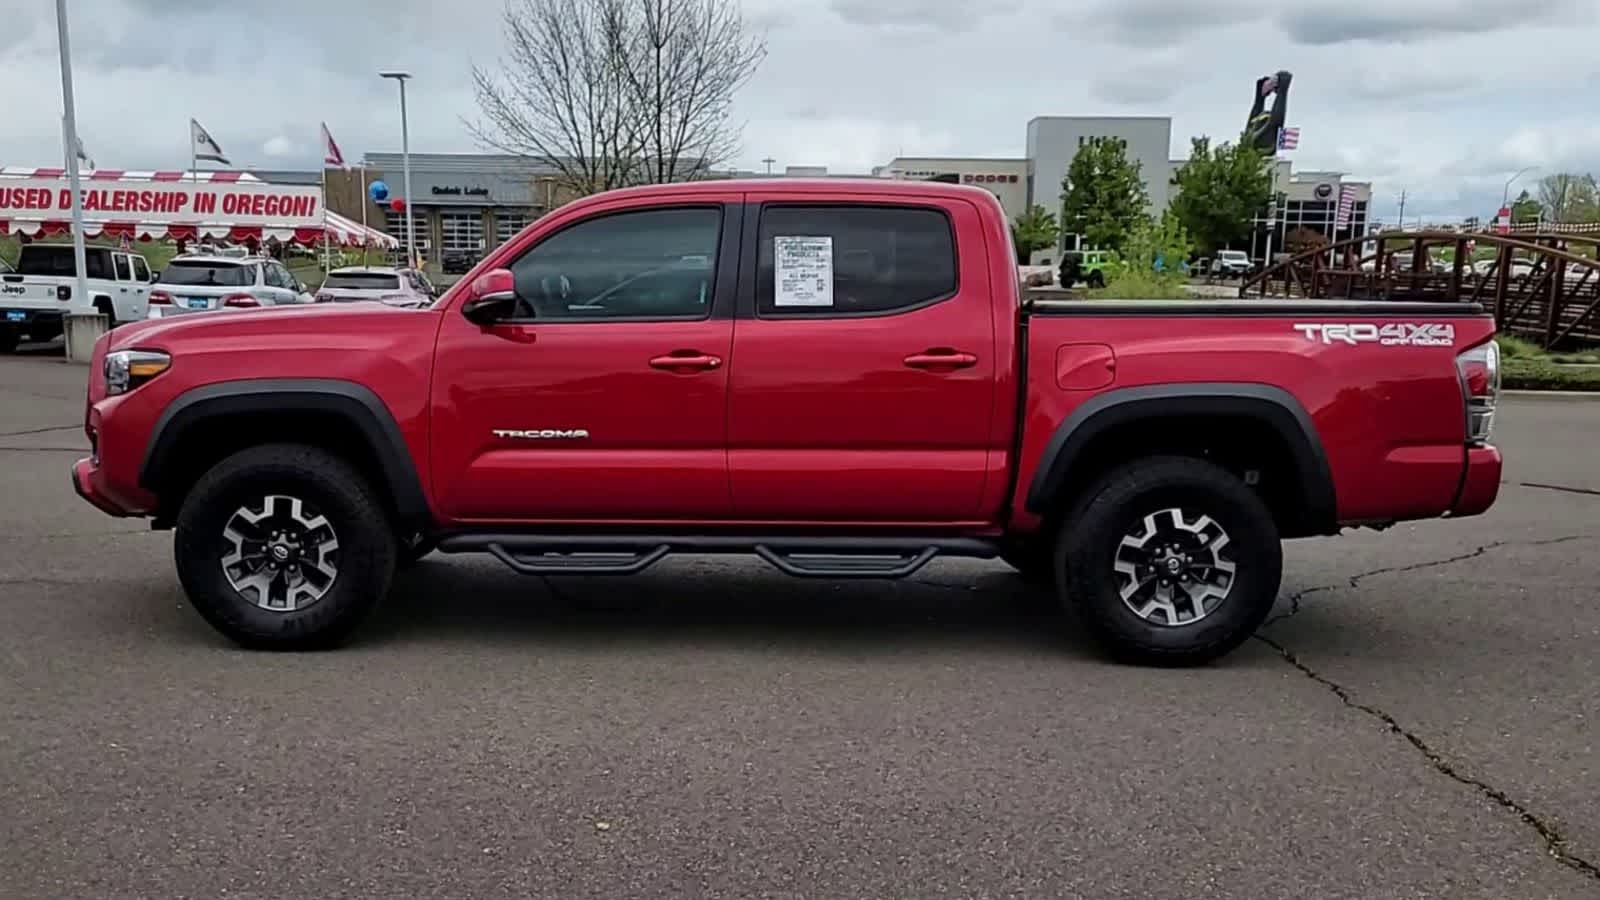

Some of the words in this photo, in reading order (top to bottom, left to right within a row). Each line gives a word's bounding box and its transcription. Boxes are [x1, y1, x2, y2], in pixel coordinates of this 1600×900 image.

[0, 188, 52, 209] USED
[193, 192, 217, 214] IN
[222, 193, 317, 217] OREGON!
[2, 284, 26, 295] Jeep
[1293, 323, 1379, 345] TRD
[1380, 338, 1410, 346] OFF
[1411, 338, 1453, 346] ROAD
[492, 429, 589, 438] TACOMA
